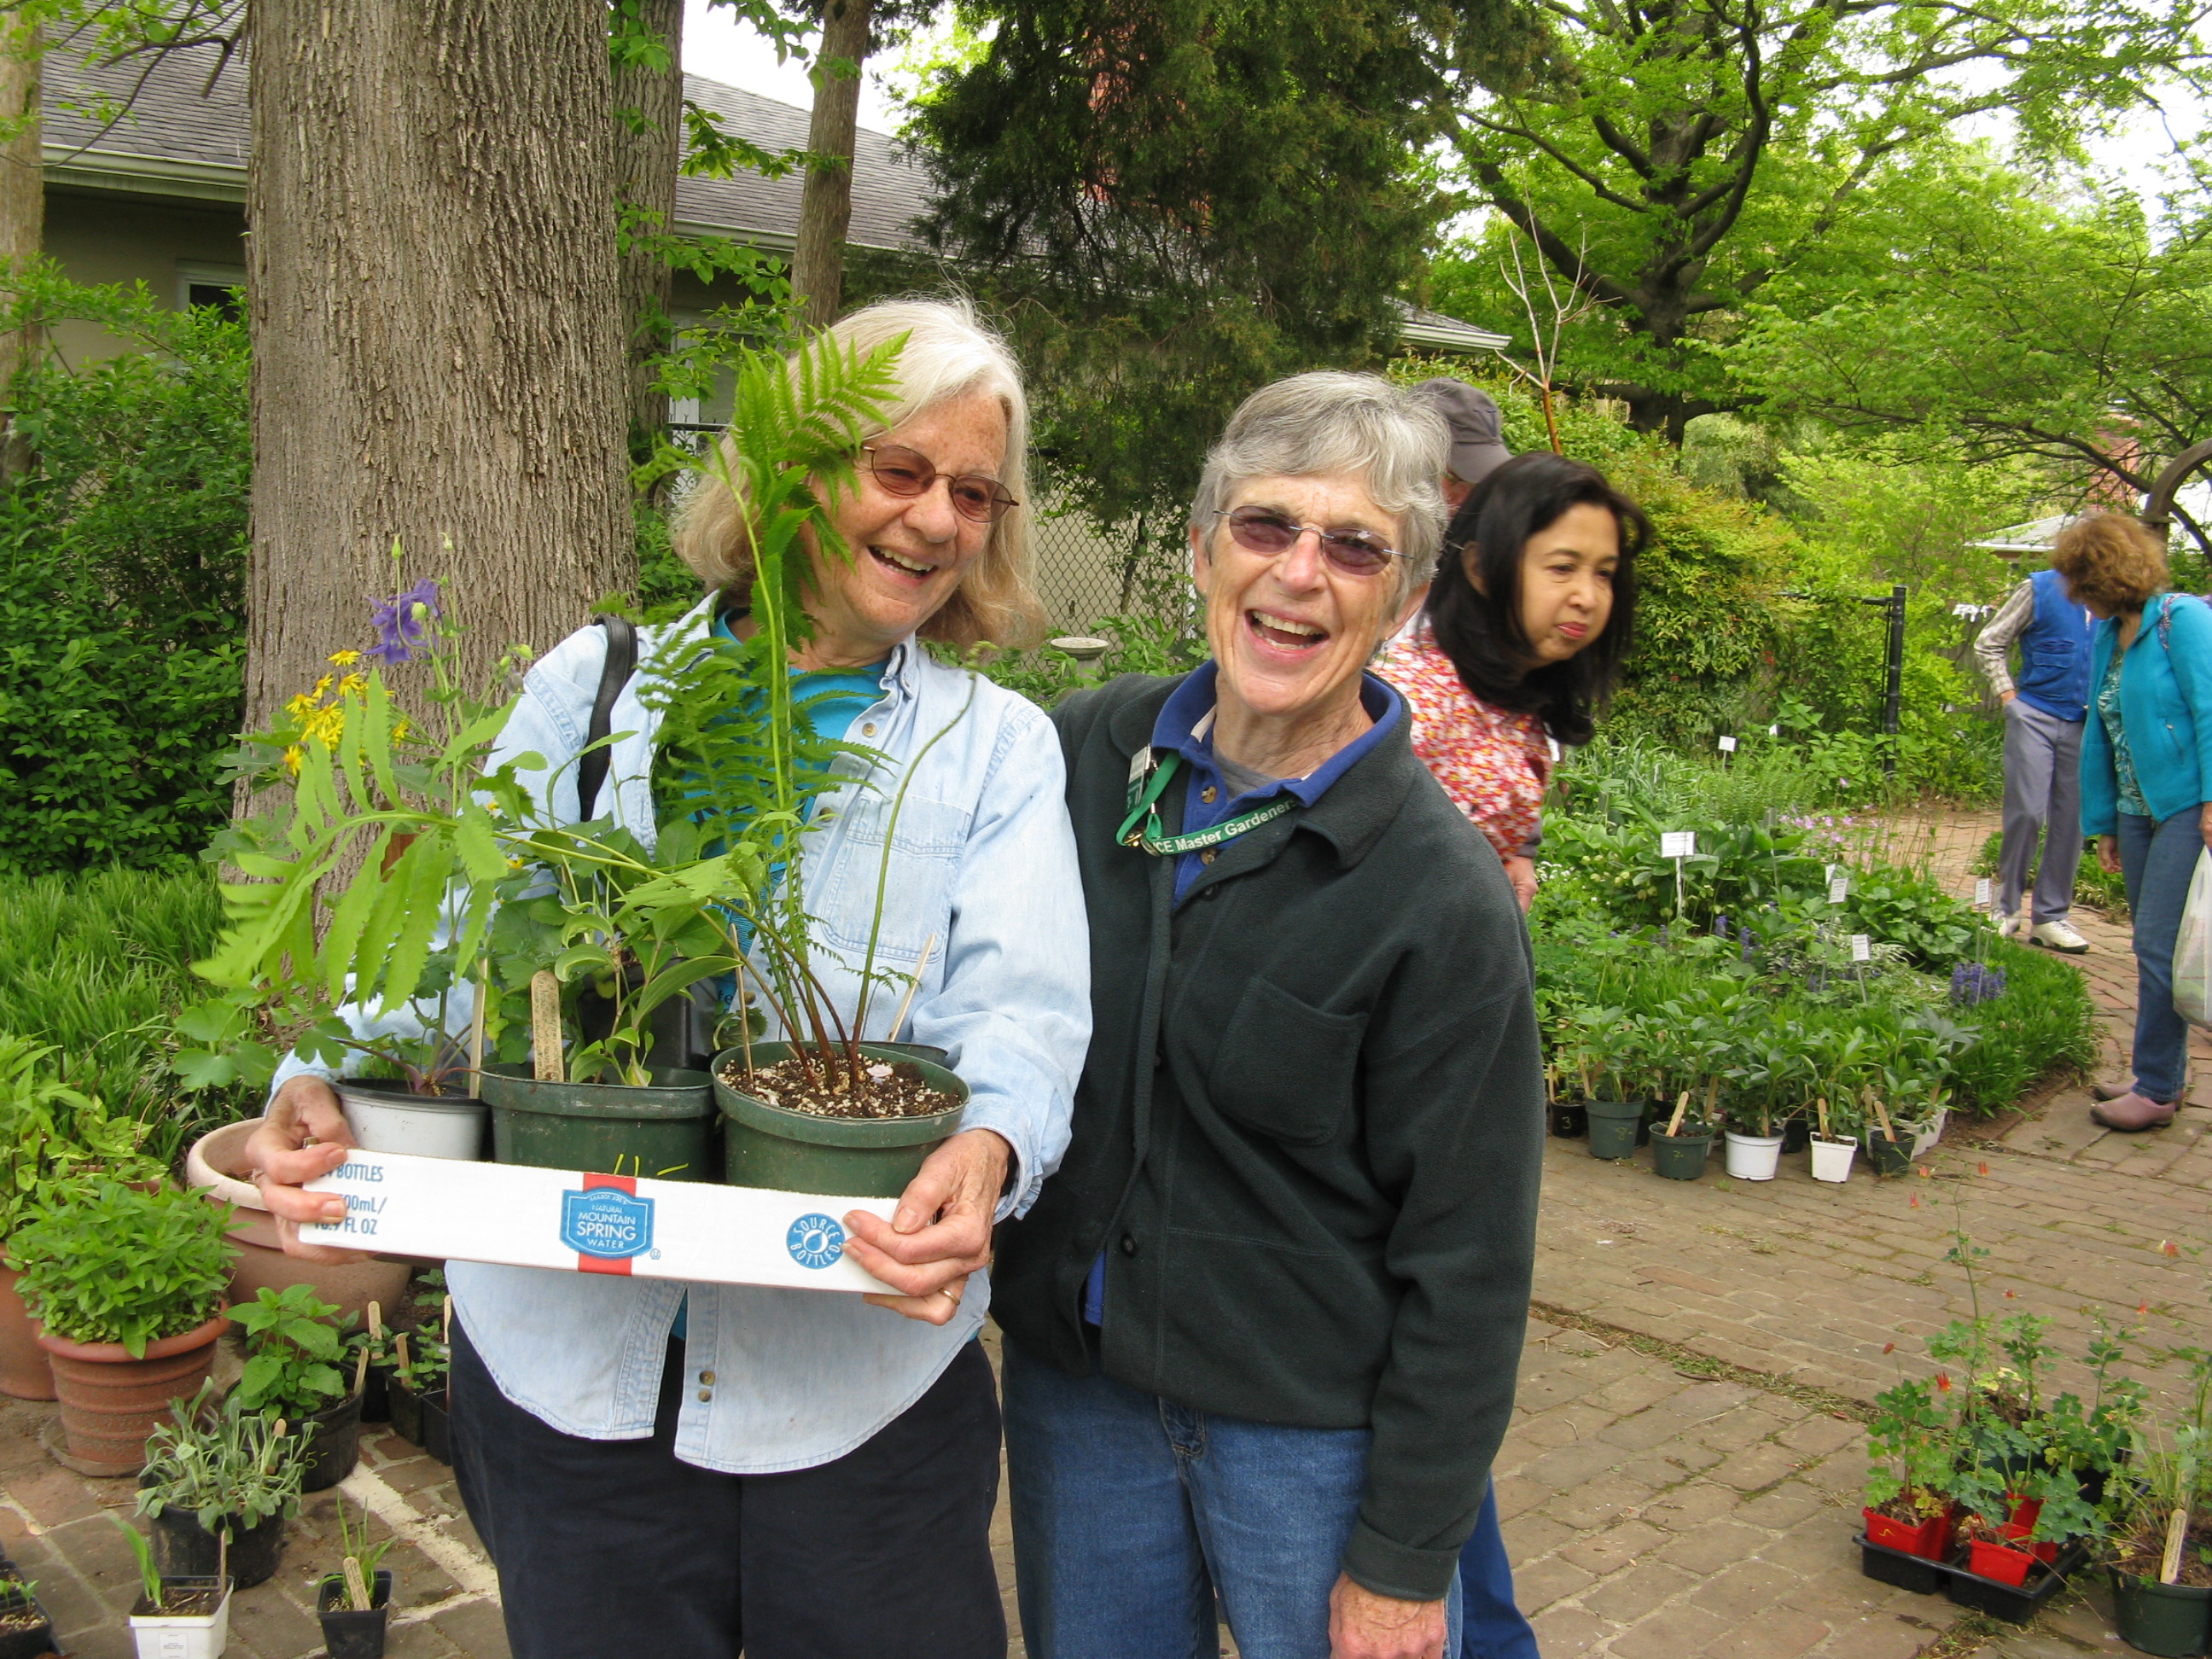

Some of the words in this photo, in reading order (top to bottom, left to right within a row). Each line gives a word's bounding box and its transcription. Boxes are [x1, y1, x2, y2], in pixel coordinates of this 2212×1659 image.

[1176, 830, 1222, 852] Master
[336, 1162, 384, 1182] BOTTLES
[577, 1212, 637, 1225] MOUNTAIN
[591, 1204, 624, 1214] NATURAL
[345, 1216, 358, 1233] FL
[360, 1217, 379, 1236] OZ
[576, 1221, 637, 1241] SPRING
[793, 1216, 841, 1239] SOURCE
[586, 1237, 625, 1249] WATER
